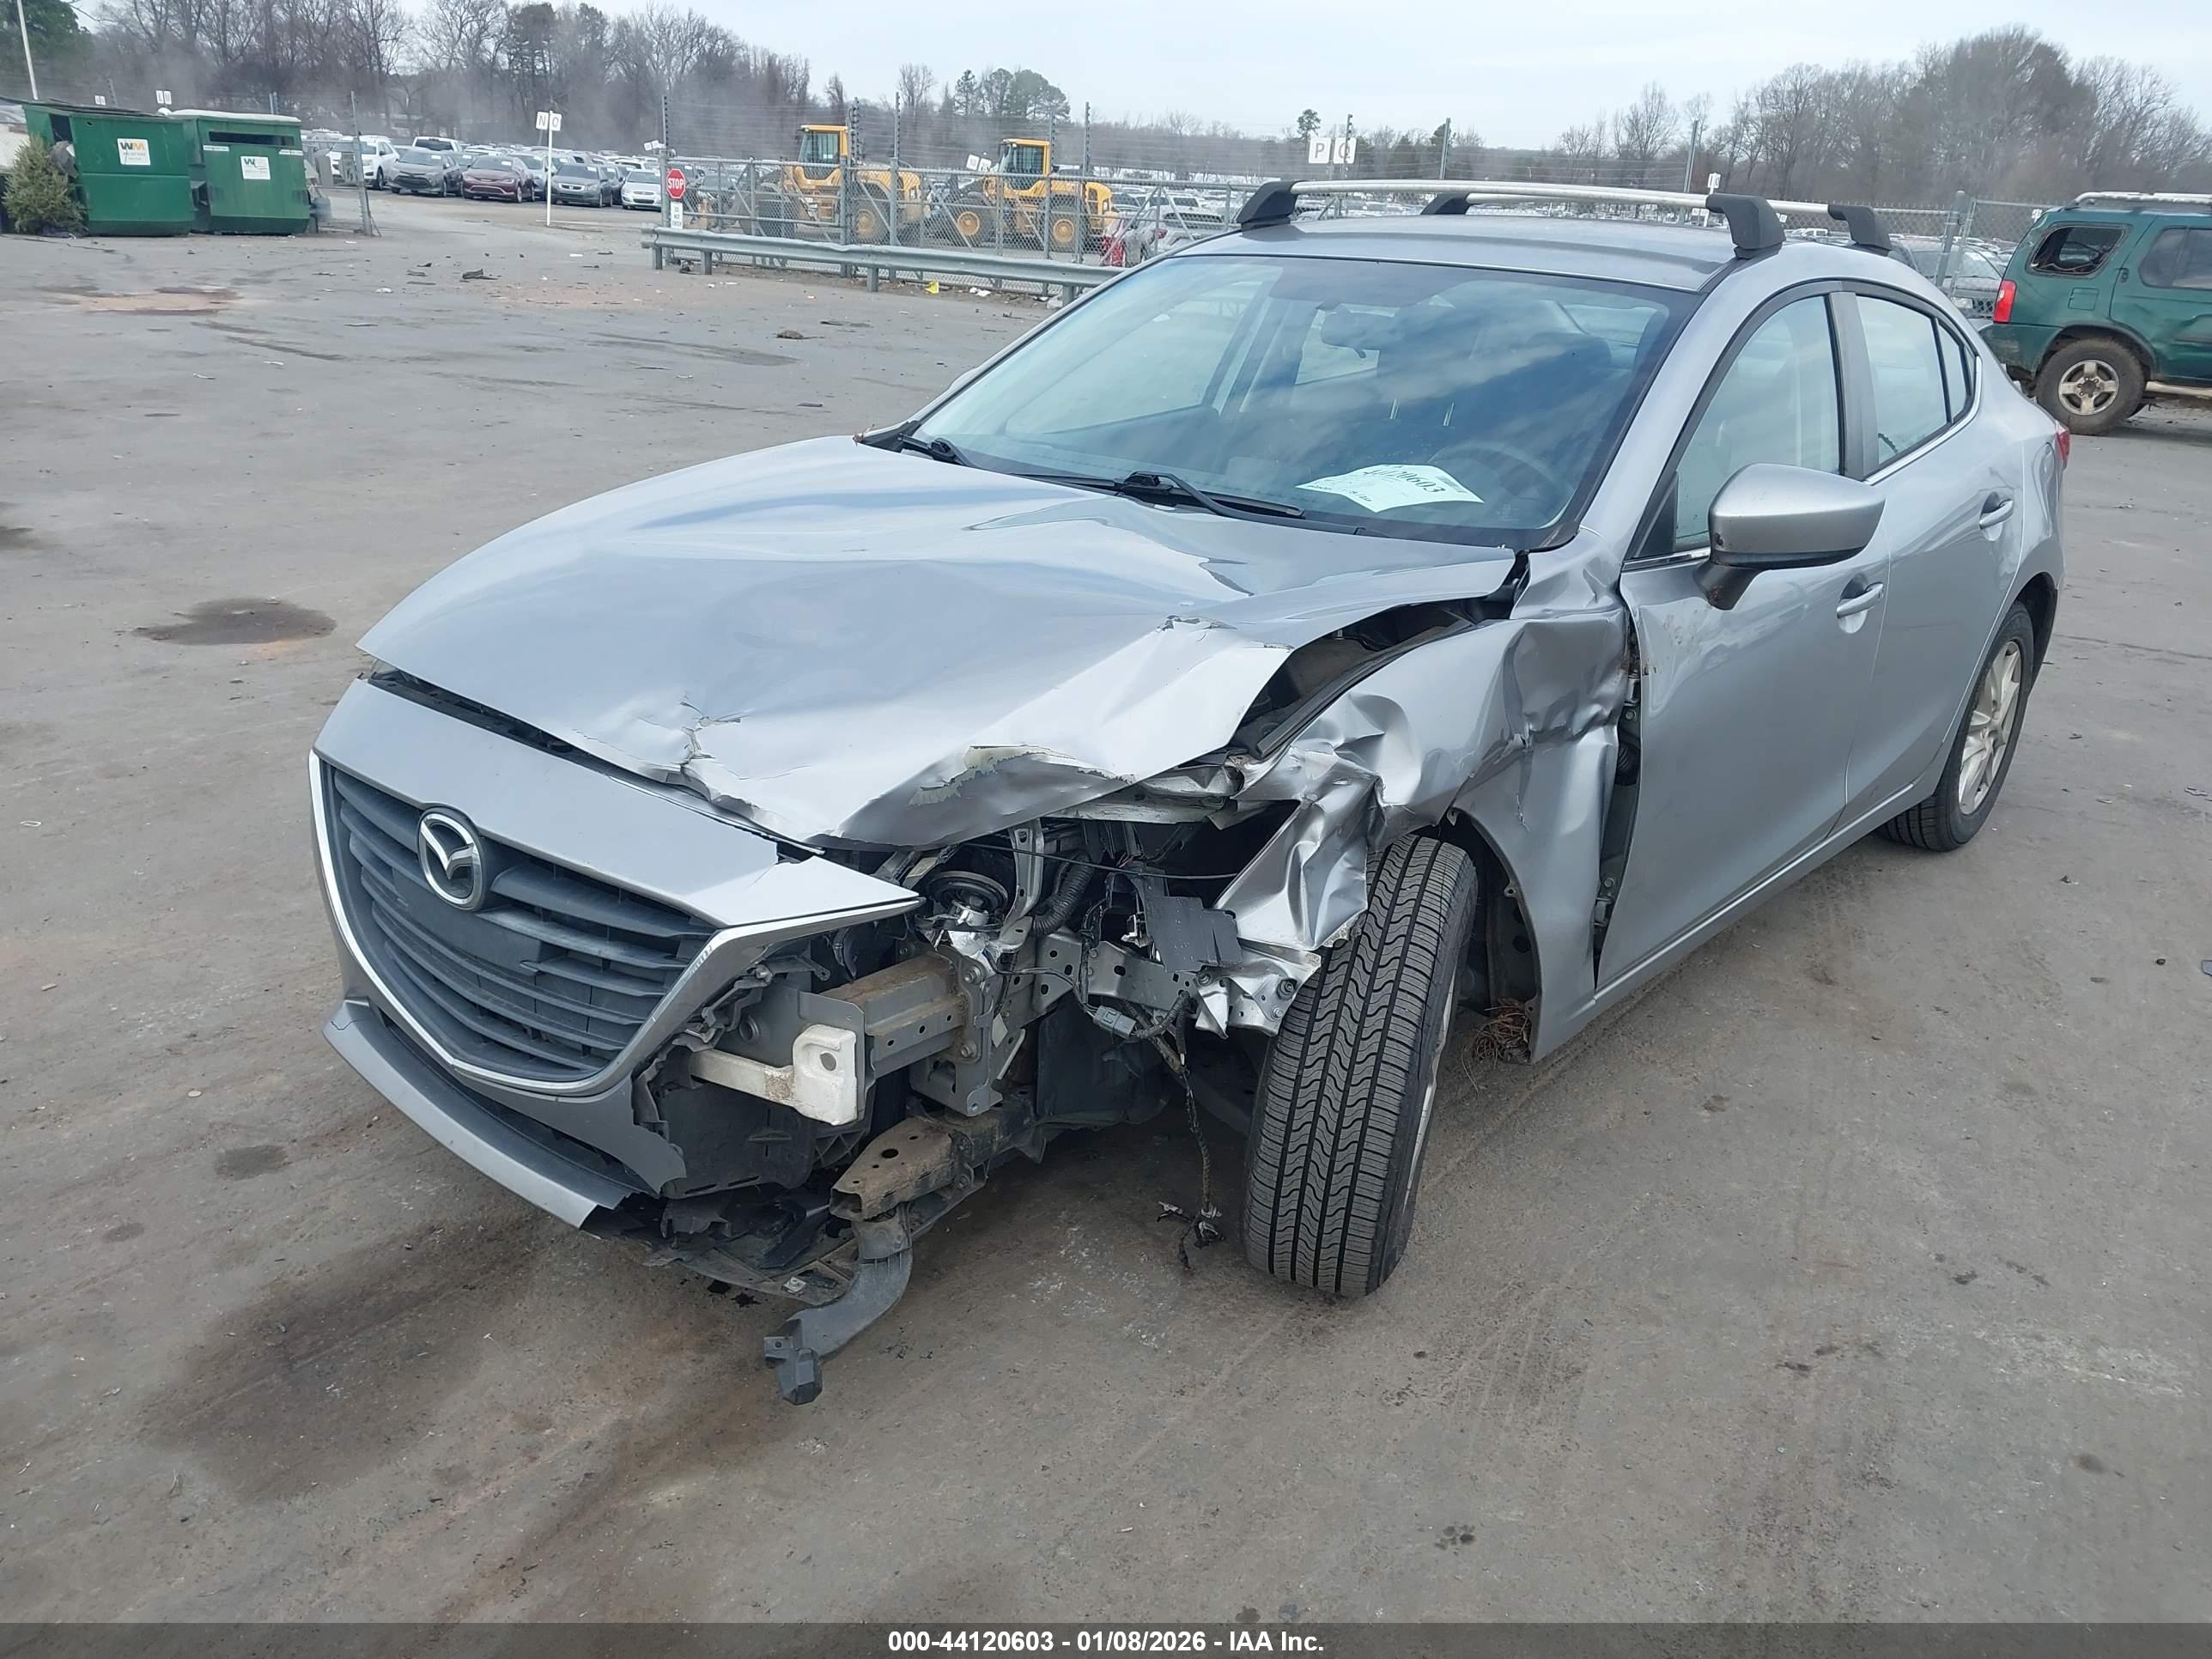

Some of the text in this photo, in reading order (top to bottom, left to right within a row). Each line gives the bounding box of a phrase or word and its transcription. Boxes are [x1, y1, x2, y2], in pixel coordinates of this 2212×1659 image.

[538, 115, 546, 126] N
[120, 142, 145, 150] WM
[1315, 143, 1351, 159] P Q
[668, 178, 684, 189] STOP
